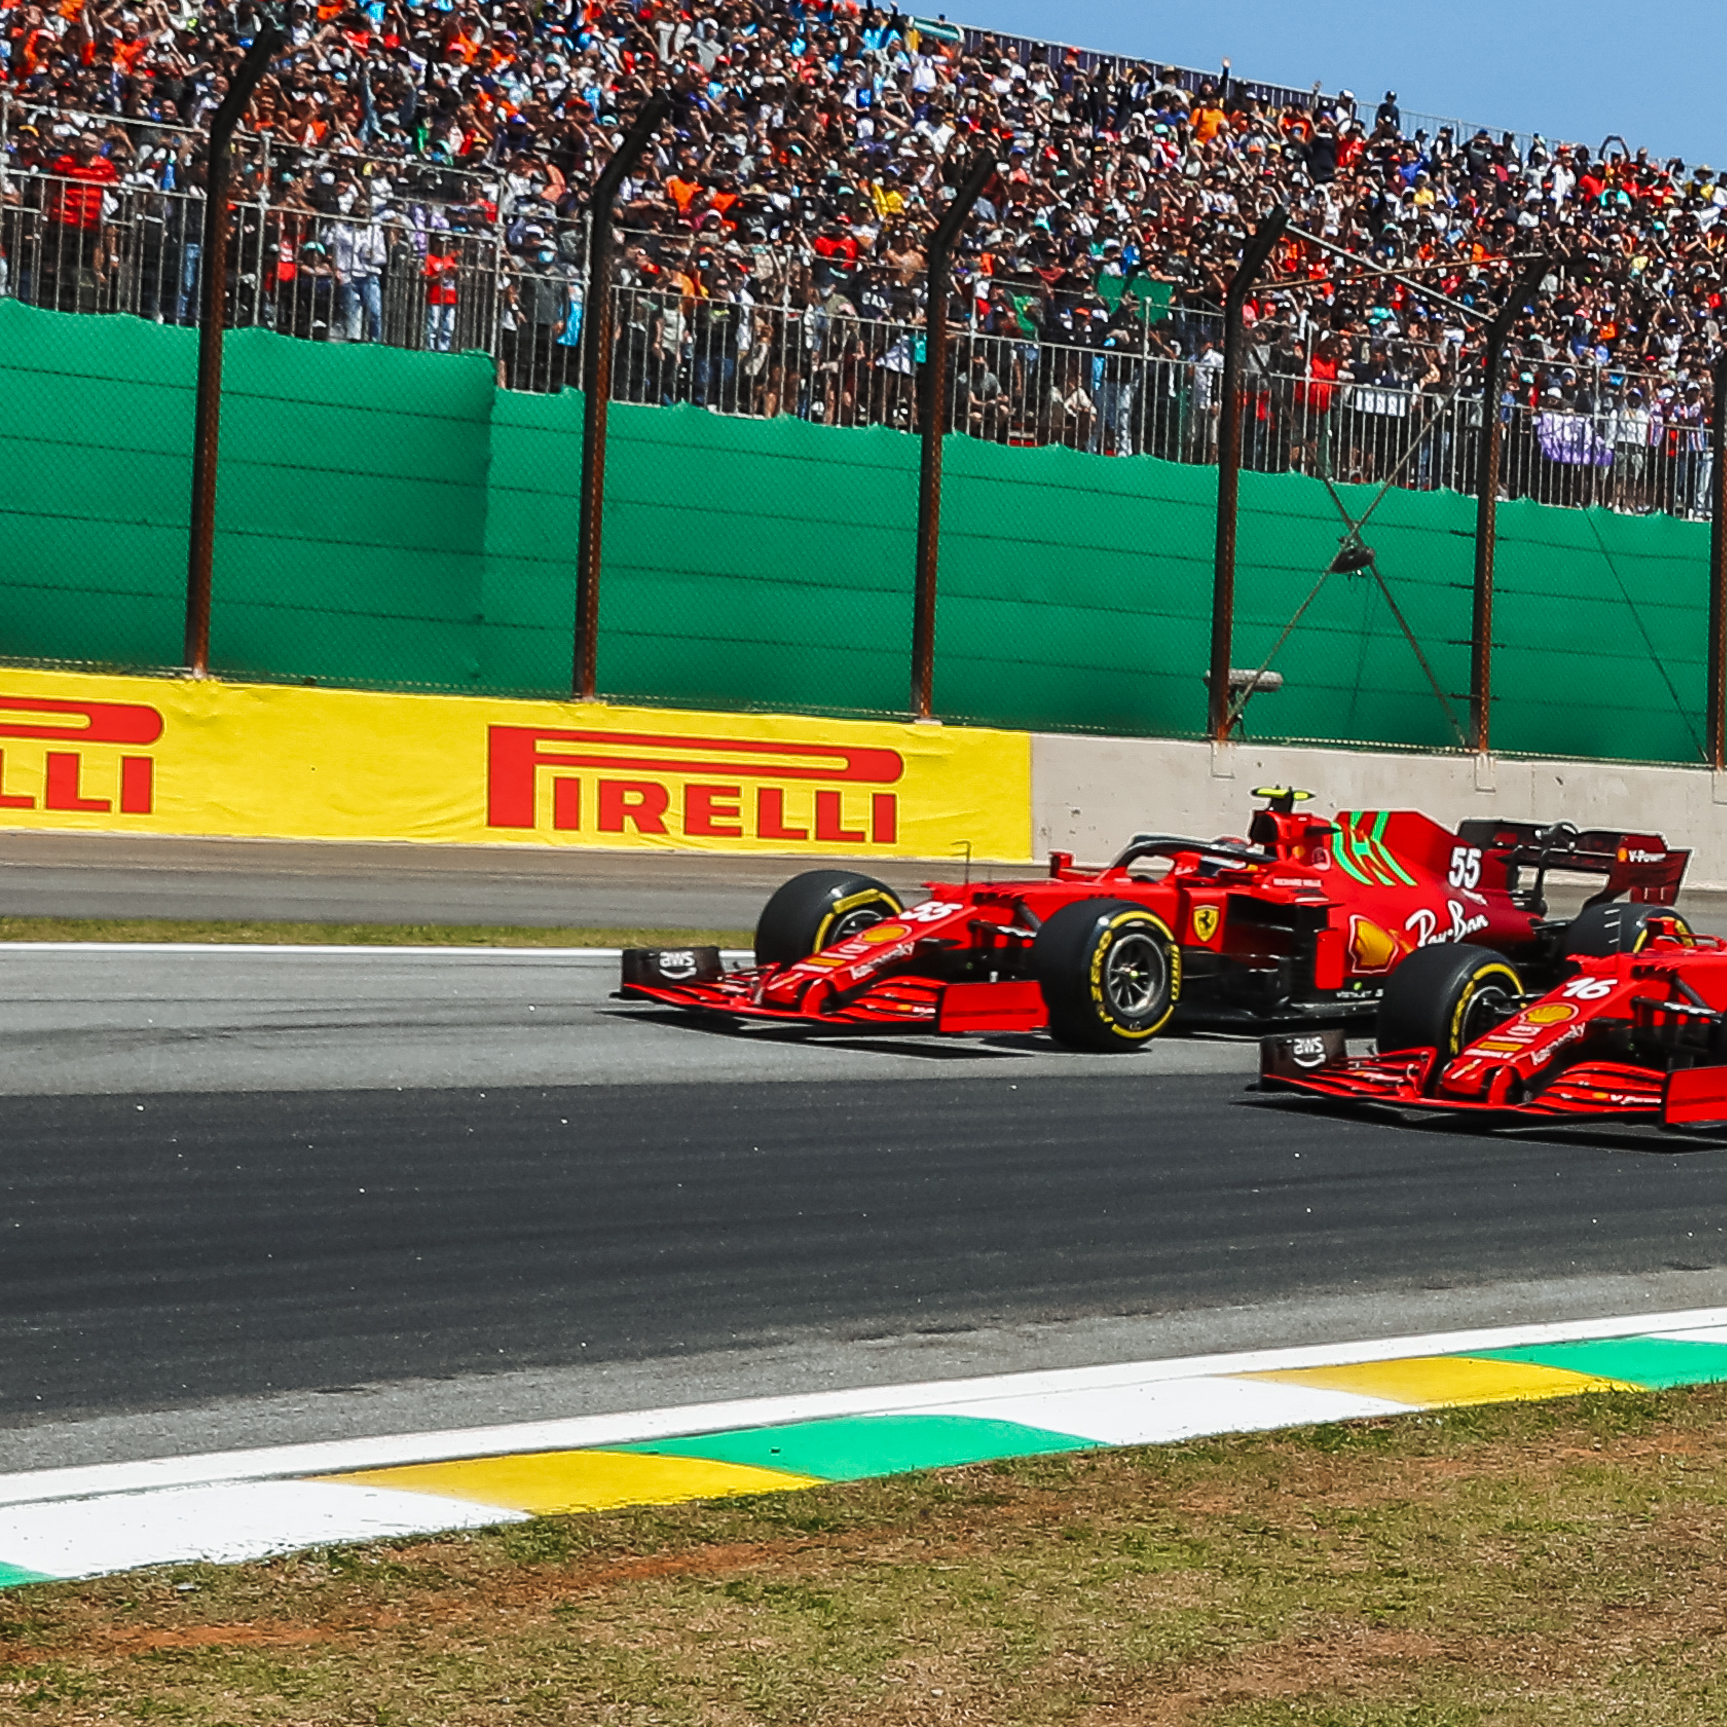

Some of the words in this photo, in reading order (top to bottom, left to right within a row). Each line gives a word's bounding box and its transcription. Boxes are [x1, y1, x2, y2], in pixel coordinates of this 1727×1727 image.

[488, 725, 903, 844] PIRELLI
[1449, 847, 1482, 889] 55
[899, 901, 964, 922] 55
[1561, 976, 1619, 1000] 16
[1293, 1036, 1325, 1055] aws
